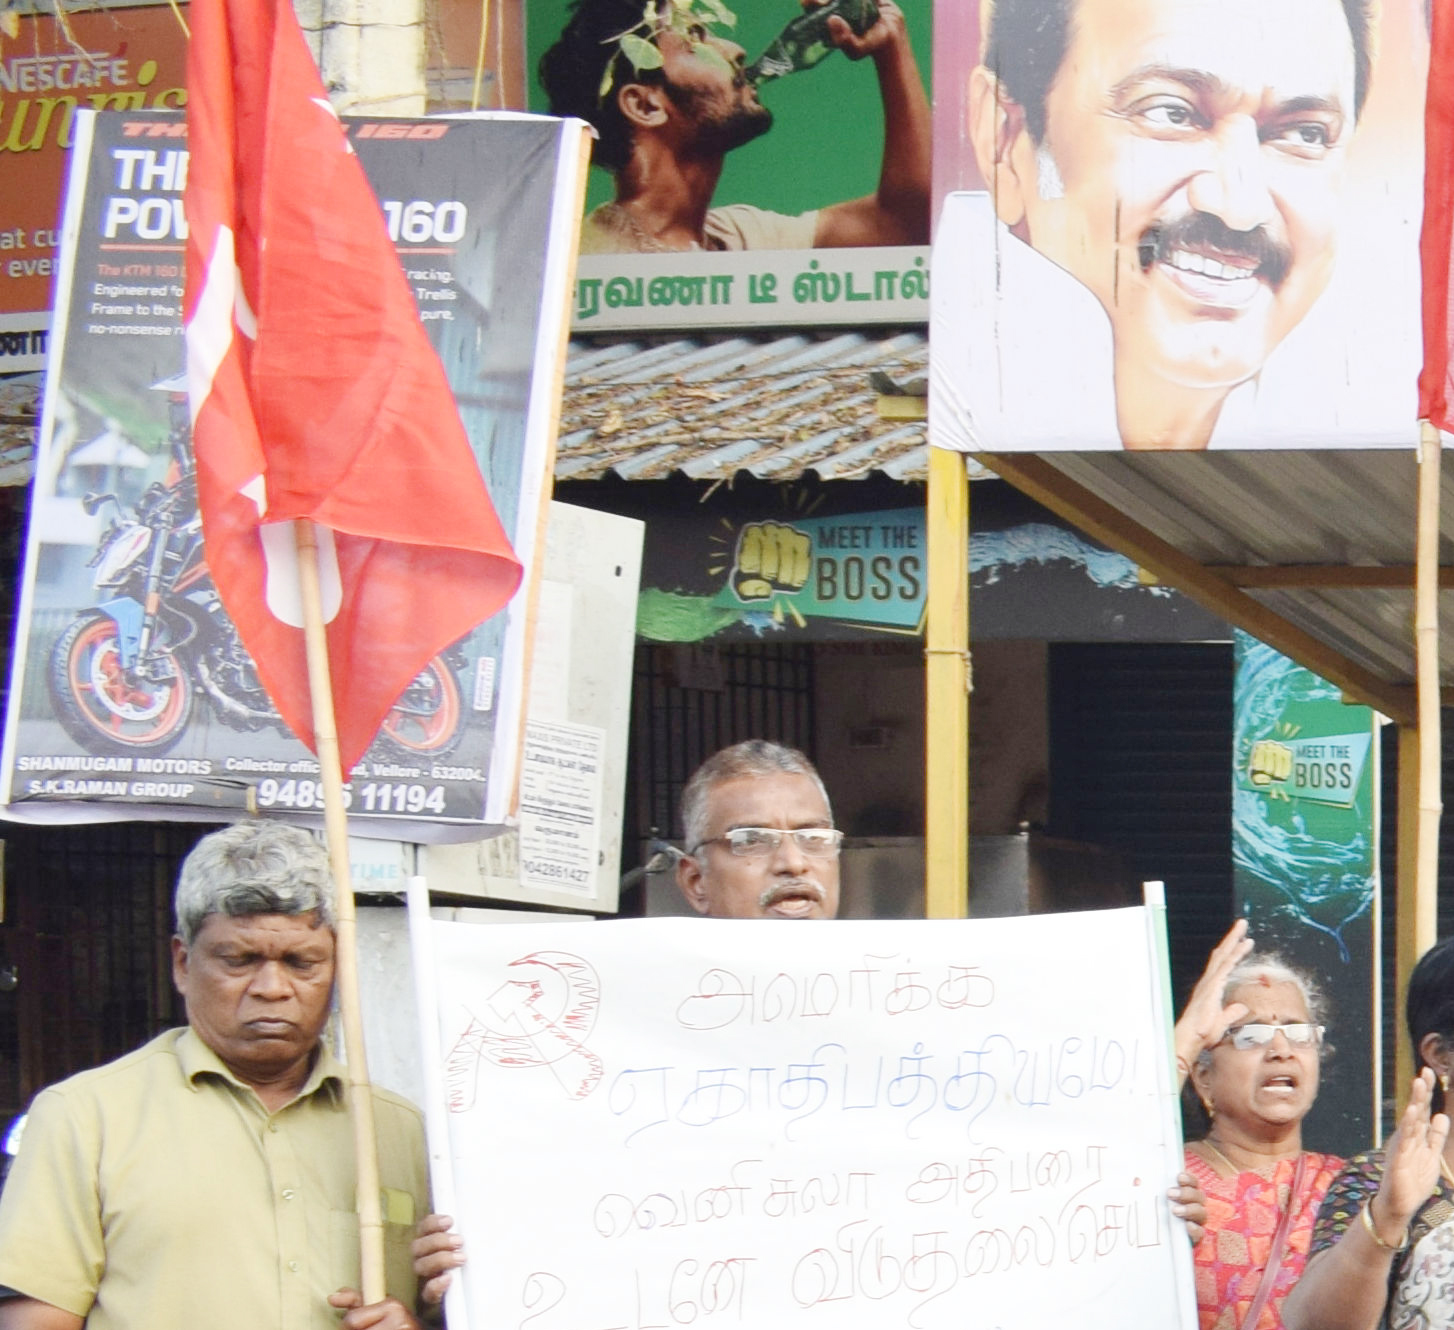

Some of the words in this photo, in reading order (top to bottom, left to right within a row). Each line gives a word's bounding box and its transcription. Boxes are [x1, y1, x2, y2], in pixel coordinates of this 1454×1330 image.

[356, 124, 449, 139] 160
[383, 201, 467, 242] 160
[94, 283, 168, 298] Engineered
[574, 272, 734, 319] ரவணா
[748, 277, 780, 303] டீ
[793, 256, 931, 304] ஸ்டால்
[91, 302, 134, 315] Frame
[135, 304, 151, 315] to
[152, 304, 176, 316] the
[88, 324, 172, 336] no-nonsense
[817, 526, 873, 549] MEET
[881, 526, 918, 549] THE
[816, 556, 921, 602] BOSS
[1296, 745, 1326, 759] MEET
[1330, 745, 1351, 759] THE
[18, 757, 132, 772] SHANMUGAM
[137, 758, 212, 774] MOTORS
[226, 758, 286, 772] Collector
[289, 760, 320, 773] offic
[374, 764, 420, 778] Vellore
[1295, 763, 1352, 788] BOSS
[29, 780, 127, 796] S.K.RAMAN
[131, 782, 194, 798] GROUP
[361, 783, 446, 813] 11194
